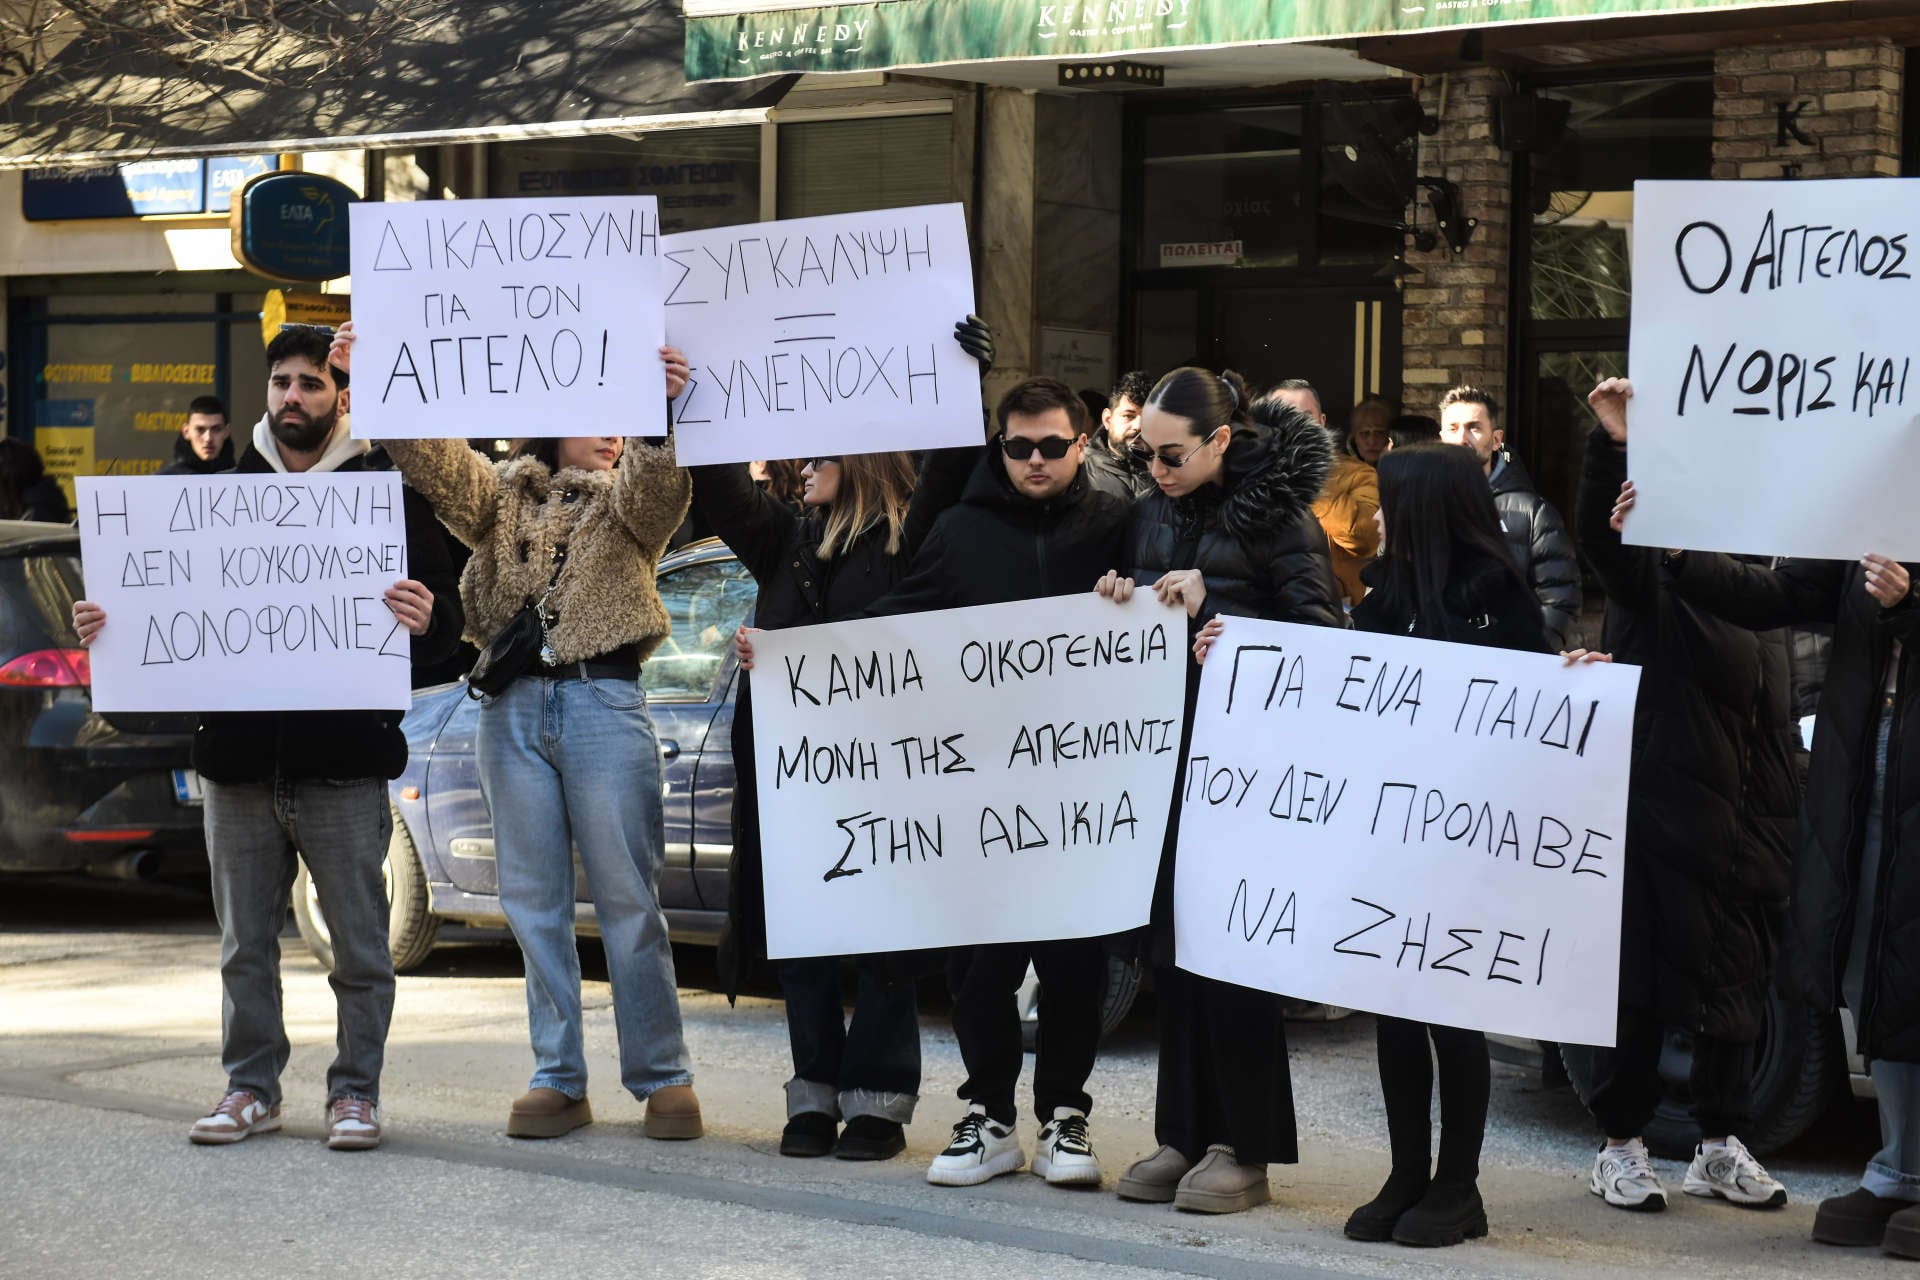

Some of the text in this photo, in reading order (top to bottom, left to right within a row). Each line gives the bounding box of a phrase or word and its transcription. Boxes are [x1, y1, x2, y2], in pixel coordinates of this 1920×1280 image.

[737, 19, 869, 51] KENNEDY
[1037, 0, 1191, 28] KENNEDY
[279, 204, 314, 221] ΕΛΤΑ
[373, 209, 657, 272] ΔΙΚΑΙΟΣΥΝΗ
[664, 224, 931, 306] ΣΥΓΚΑΛΥΨΗ
[1162, 243, 1241, 257] ΠΩΛΕΙΤΑΙ
[1675, 209, 1911, 294] Ο ΑΓΓΕΛΟΣ
[424, 283, 582, 329] ΓΙΑ ΤΟΝ
[676, 343, 939, 424] ΣΥΝΕΝΟΧΗ
[1677, 342, 1910, 421] ΝΩΡΙΣ ΚΑΙ
[94, 483, 392, 536] Η ΔΙΚΑΙΟΣΥΝΗ
[121, 543, 405, 588] ΔΕΝ ΚΟΥΚΟΥΛΩΝΕΙ
[141, 595, 411, 666] ΔΟΛΟΦΟΝΙΕΣ
[785, 623, 1167, 707] ΚΑΜΙΑ ΟΙΚΟΓΕΝΕΙΑ
[1226, 644, 1600, 757] ΓΙΑ ΕΝΑ ΠΑΙΔΙ
[776, 718, 1175, 789] ΜΟΝΗ ΤΗΣ ΑΠΕΝΑΝΤΙ
[823, 790, 1138, 882] ΣΤΗΝ ΑΔΙΚΙΑ
[1186, 756, 1613, 878] ΠΟΥ ΔΕΝ ΠΡΟΛΑΒΕ
[1227, 878, 1551, 986] ΝΑ ΖΗΣΕΙ
